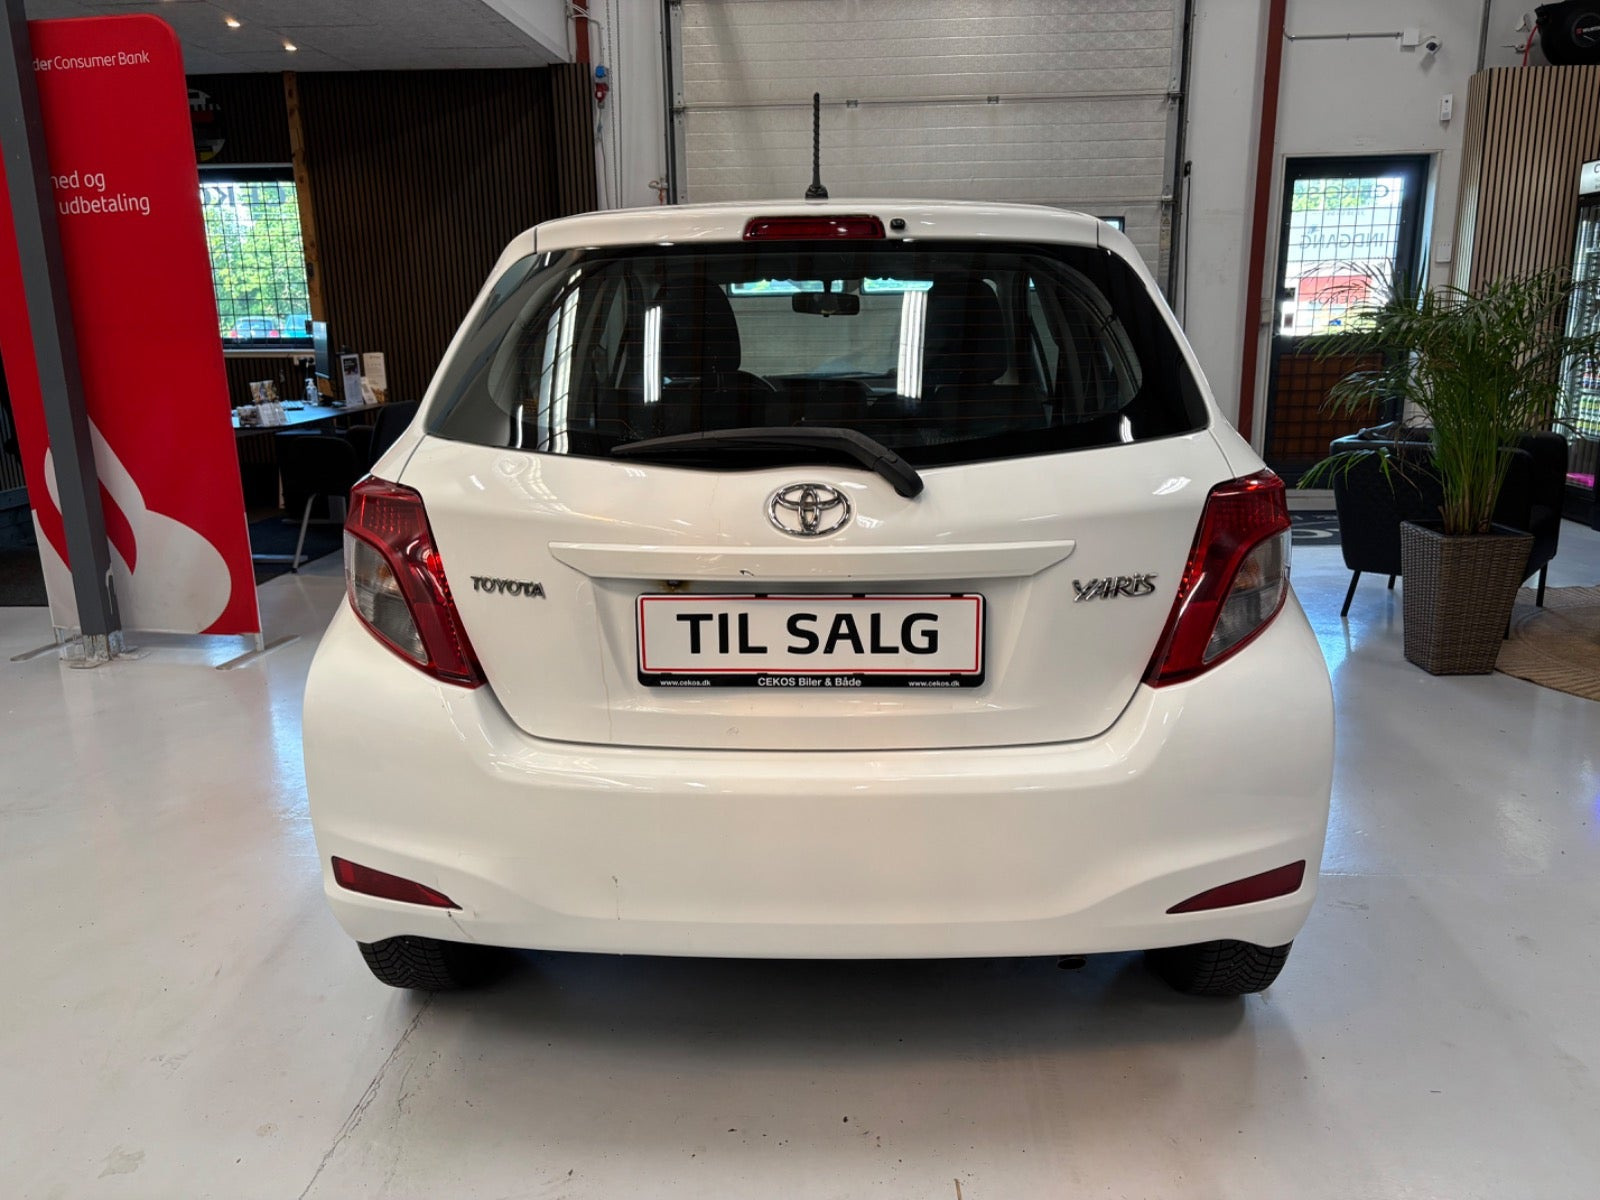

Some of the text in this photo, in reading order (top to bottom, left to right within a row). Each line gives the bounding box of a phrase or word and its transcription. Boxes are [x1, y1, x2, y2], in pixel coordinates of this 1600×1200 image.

[32, 50, 150, 71] der Consumer Bank
[83, 173, 106, 192] og
[59, 193, 150, 216] udbetaling
[470, 575, 546, 600] TOYOTA
[676, 612, 939, 655] TIL SALG
[660, 679, 711, 687] www.cekos.dk
[757, 676, 862, 687] CEKOS Biler & Både
[908, 679, 960, 688] www.cekos.dk
